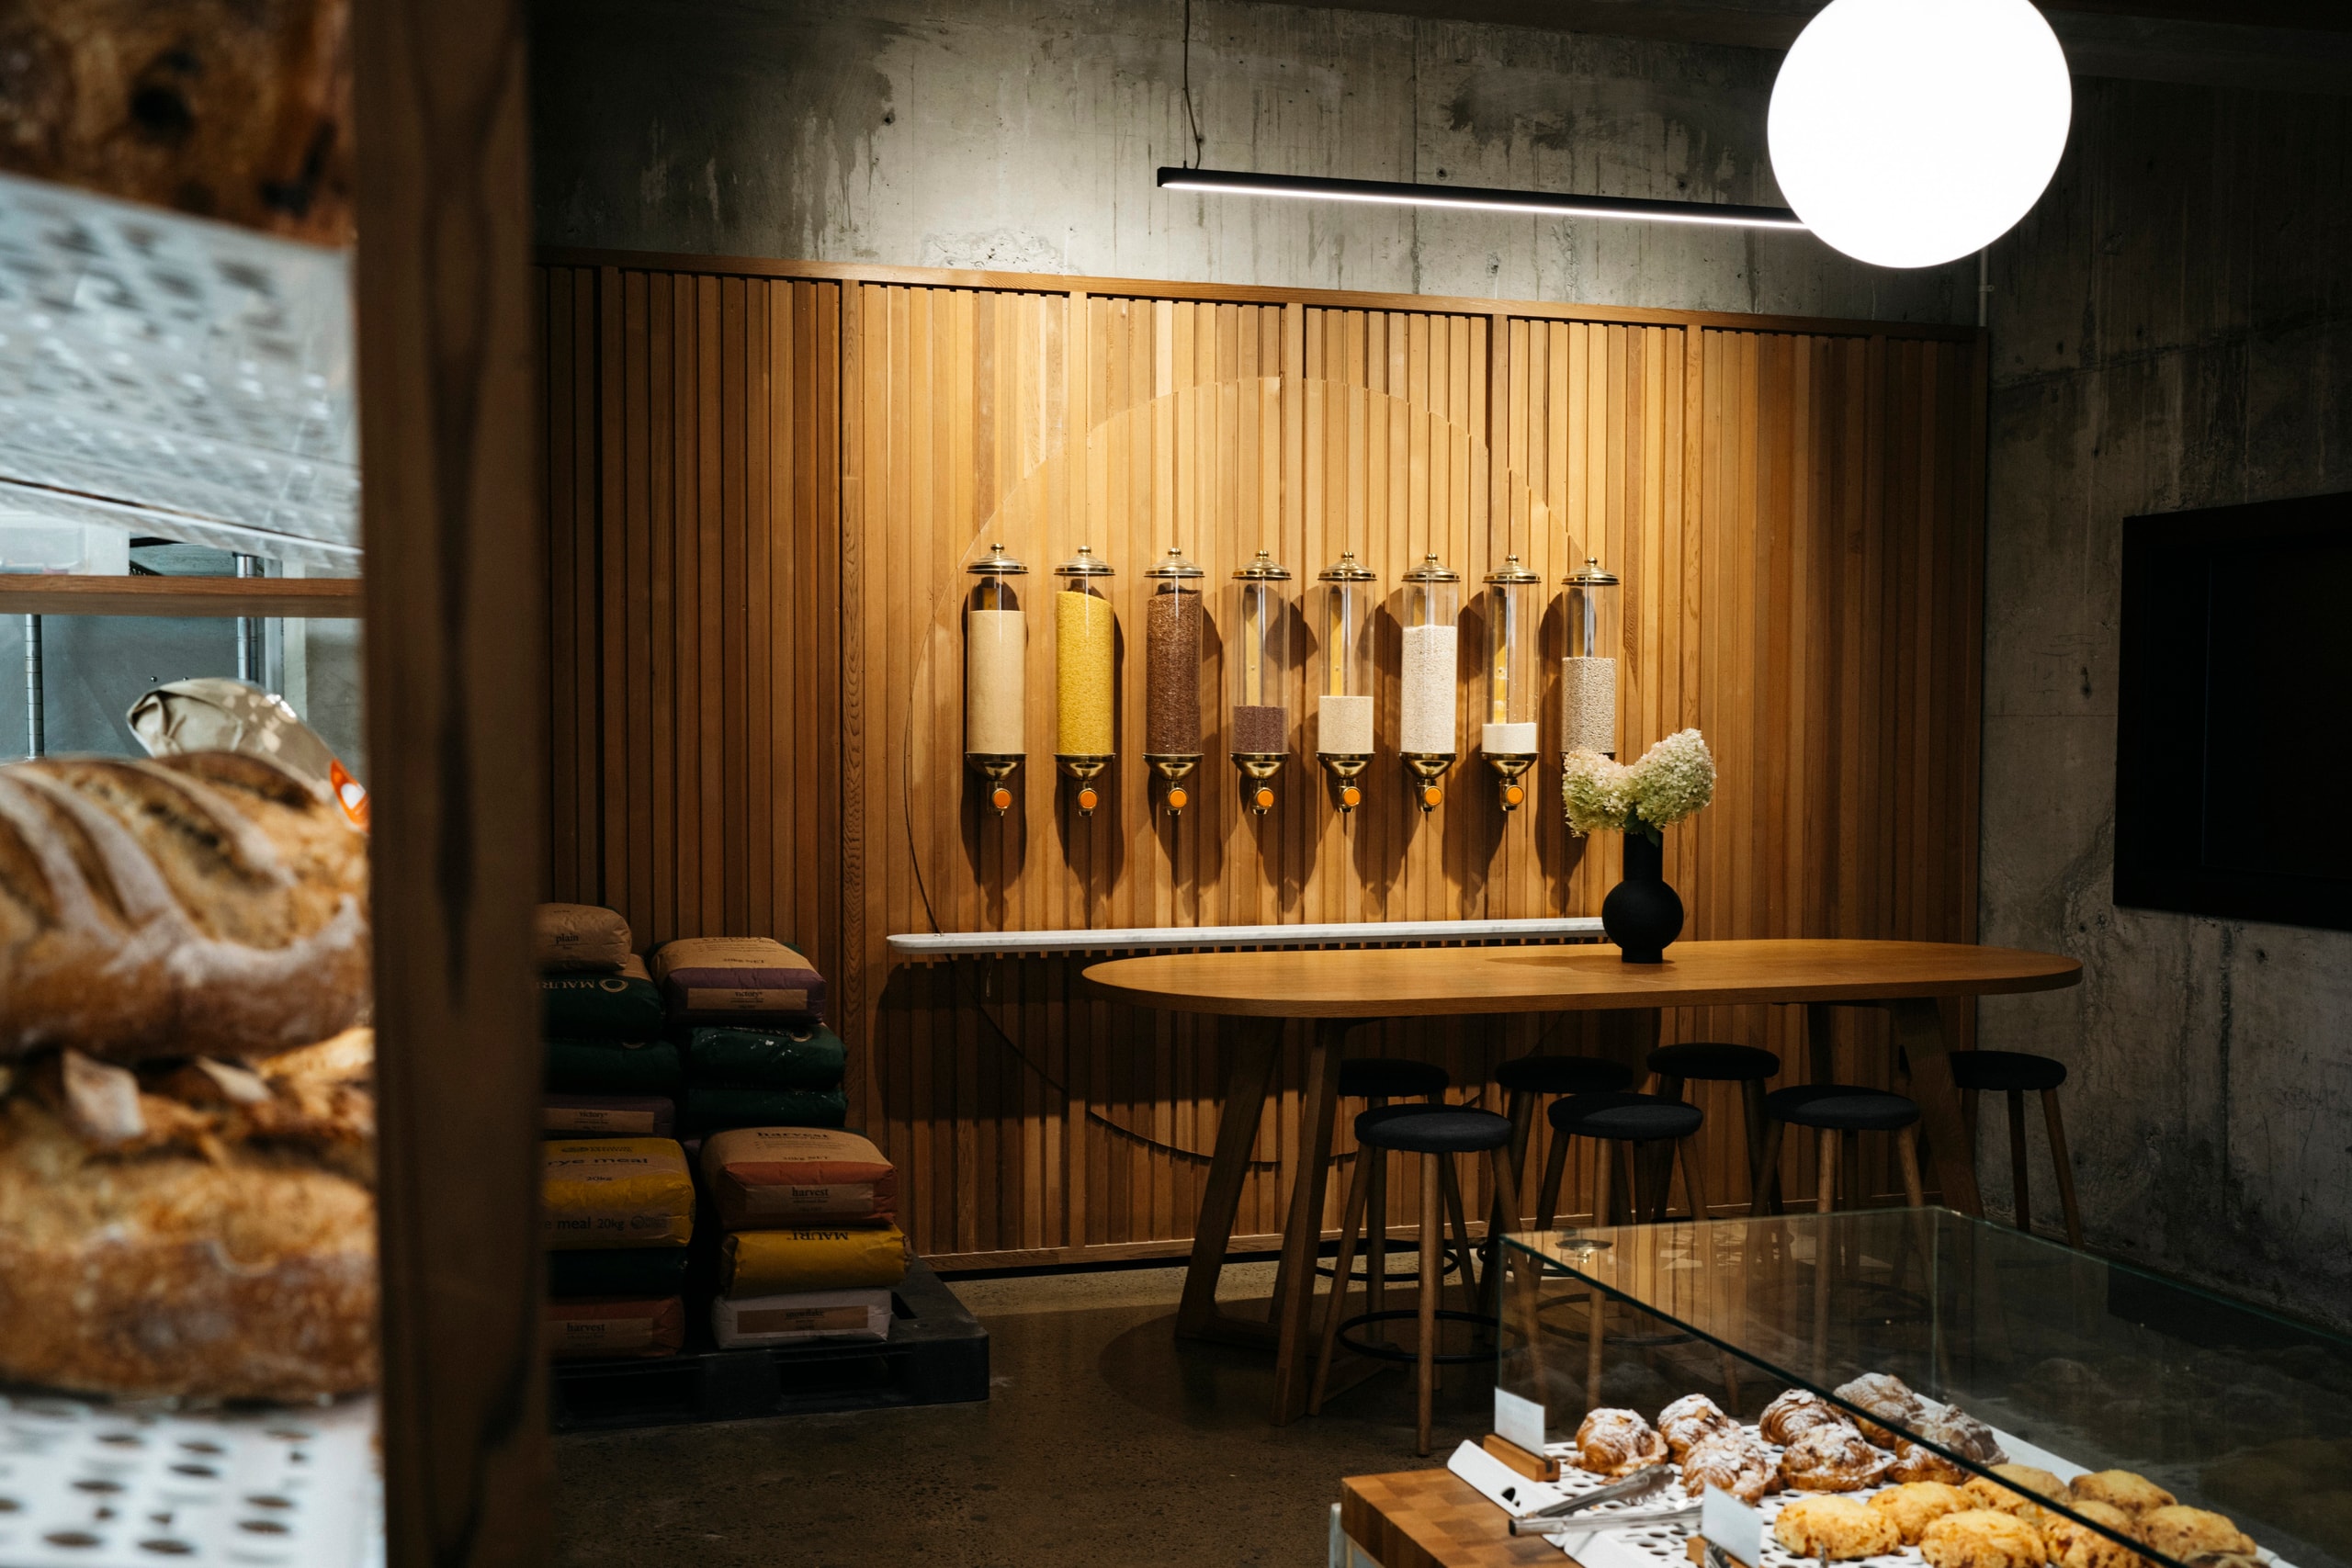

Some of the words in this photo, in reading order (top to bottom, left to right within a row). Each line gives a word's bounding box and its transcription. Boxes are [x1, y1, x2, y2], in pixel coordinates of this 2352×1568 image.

[556, 933, 579, 944] plain
[792, 1187, 830, 1197] harvest
[557, 1216, 591, 1229] meal
[596, 1218, 625, 1231] 20kg
[566, 1322, 605, 1332] harvest
